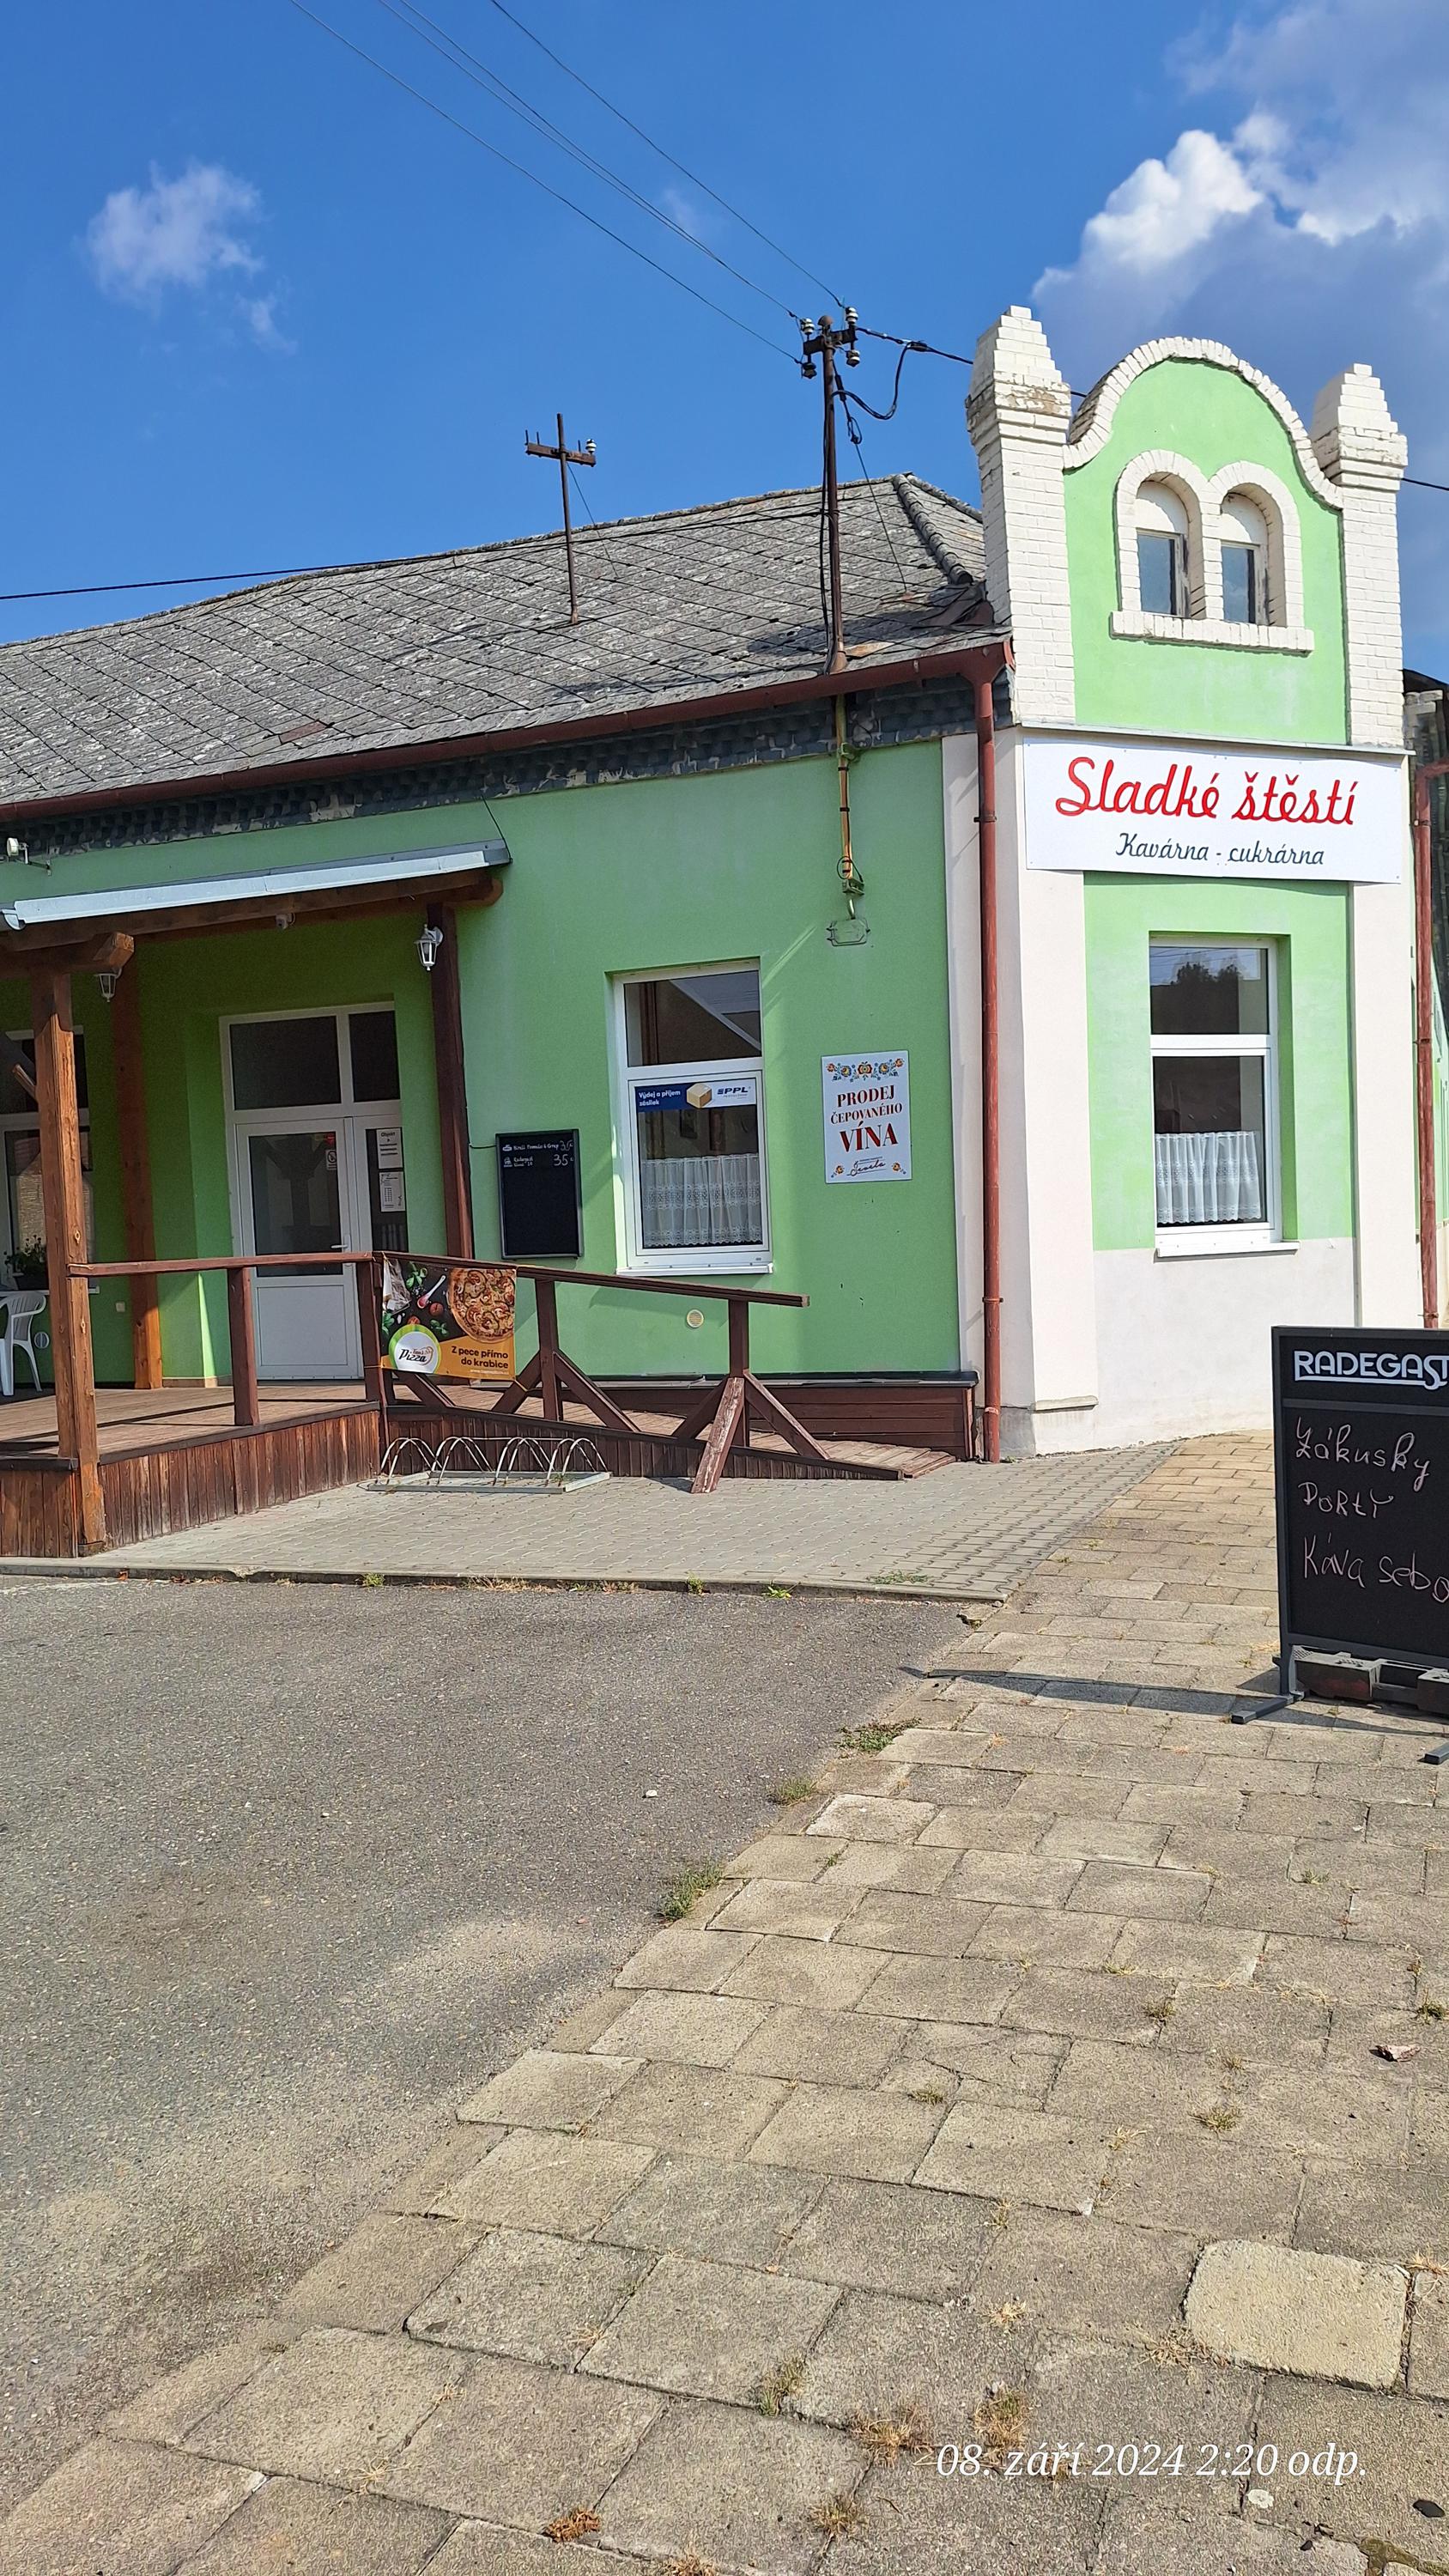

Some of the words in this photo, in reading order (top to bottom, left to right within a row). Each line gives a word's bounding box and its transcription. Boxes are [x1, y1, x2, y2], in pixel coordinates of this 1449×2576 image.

[1055, 756, 1220, 819] Sladké
[1232, 771, 1359, 825] štěstí
[1116, 833, 1209, 862] Kavárna
[1228, 841, 1325, 866] cukrárna
[639, 1091, 656, 1099] Výdej
[661, 1090, 681, 1098] příjem
[837, 1084, 894, 1108] PRODEJ
[830, 1103, 903, 1125] ČEPOVANÉHO
[839, 1121, 899, 1153] VÍNA
[553, 1153, 569, 1166] 35
[398, 1348, 427, 1363] Pizza
[452, 1346, 458, 1354] Z
[458, 1347, 480, 1357] pece
[481, 1349, 509, 1359] přímo
[460, 1357, 472, 1365] do
[473, 1358, 509, 1369] krabice
[1294, 1351, 1449, 1390] RADEGAST
